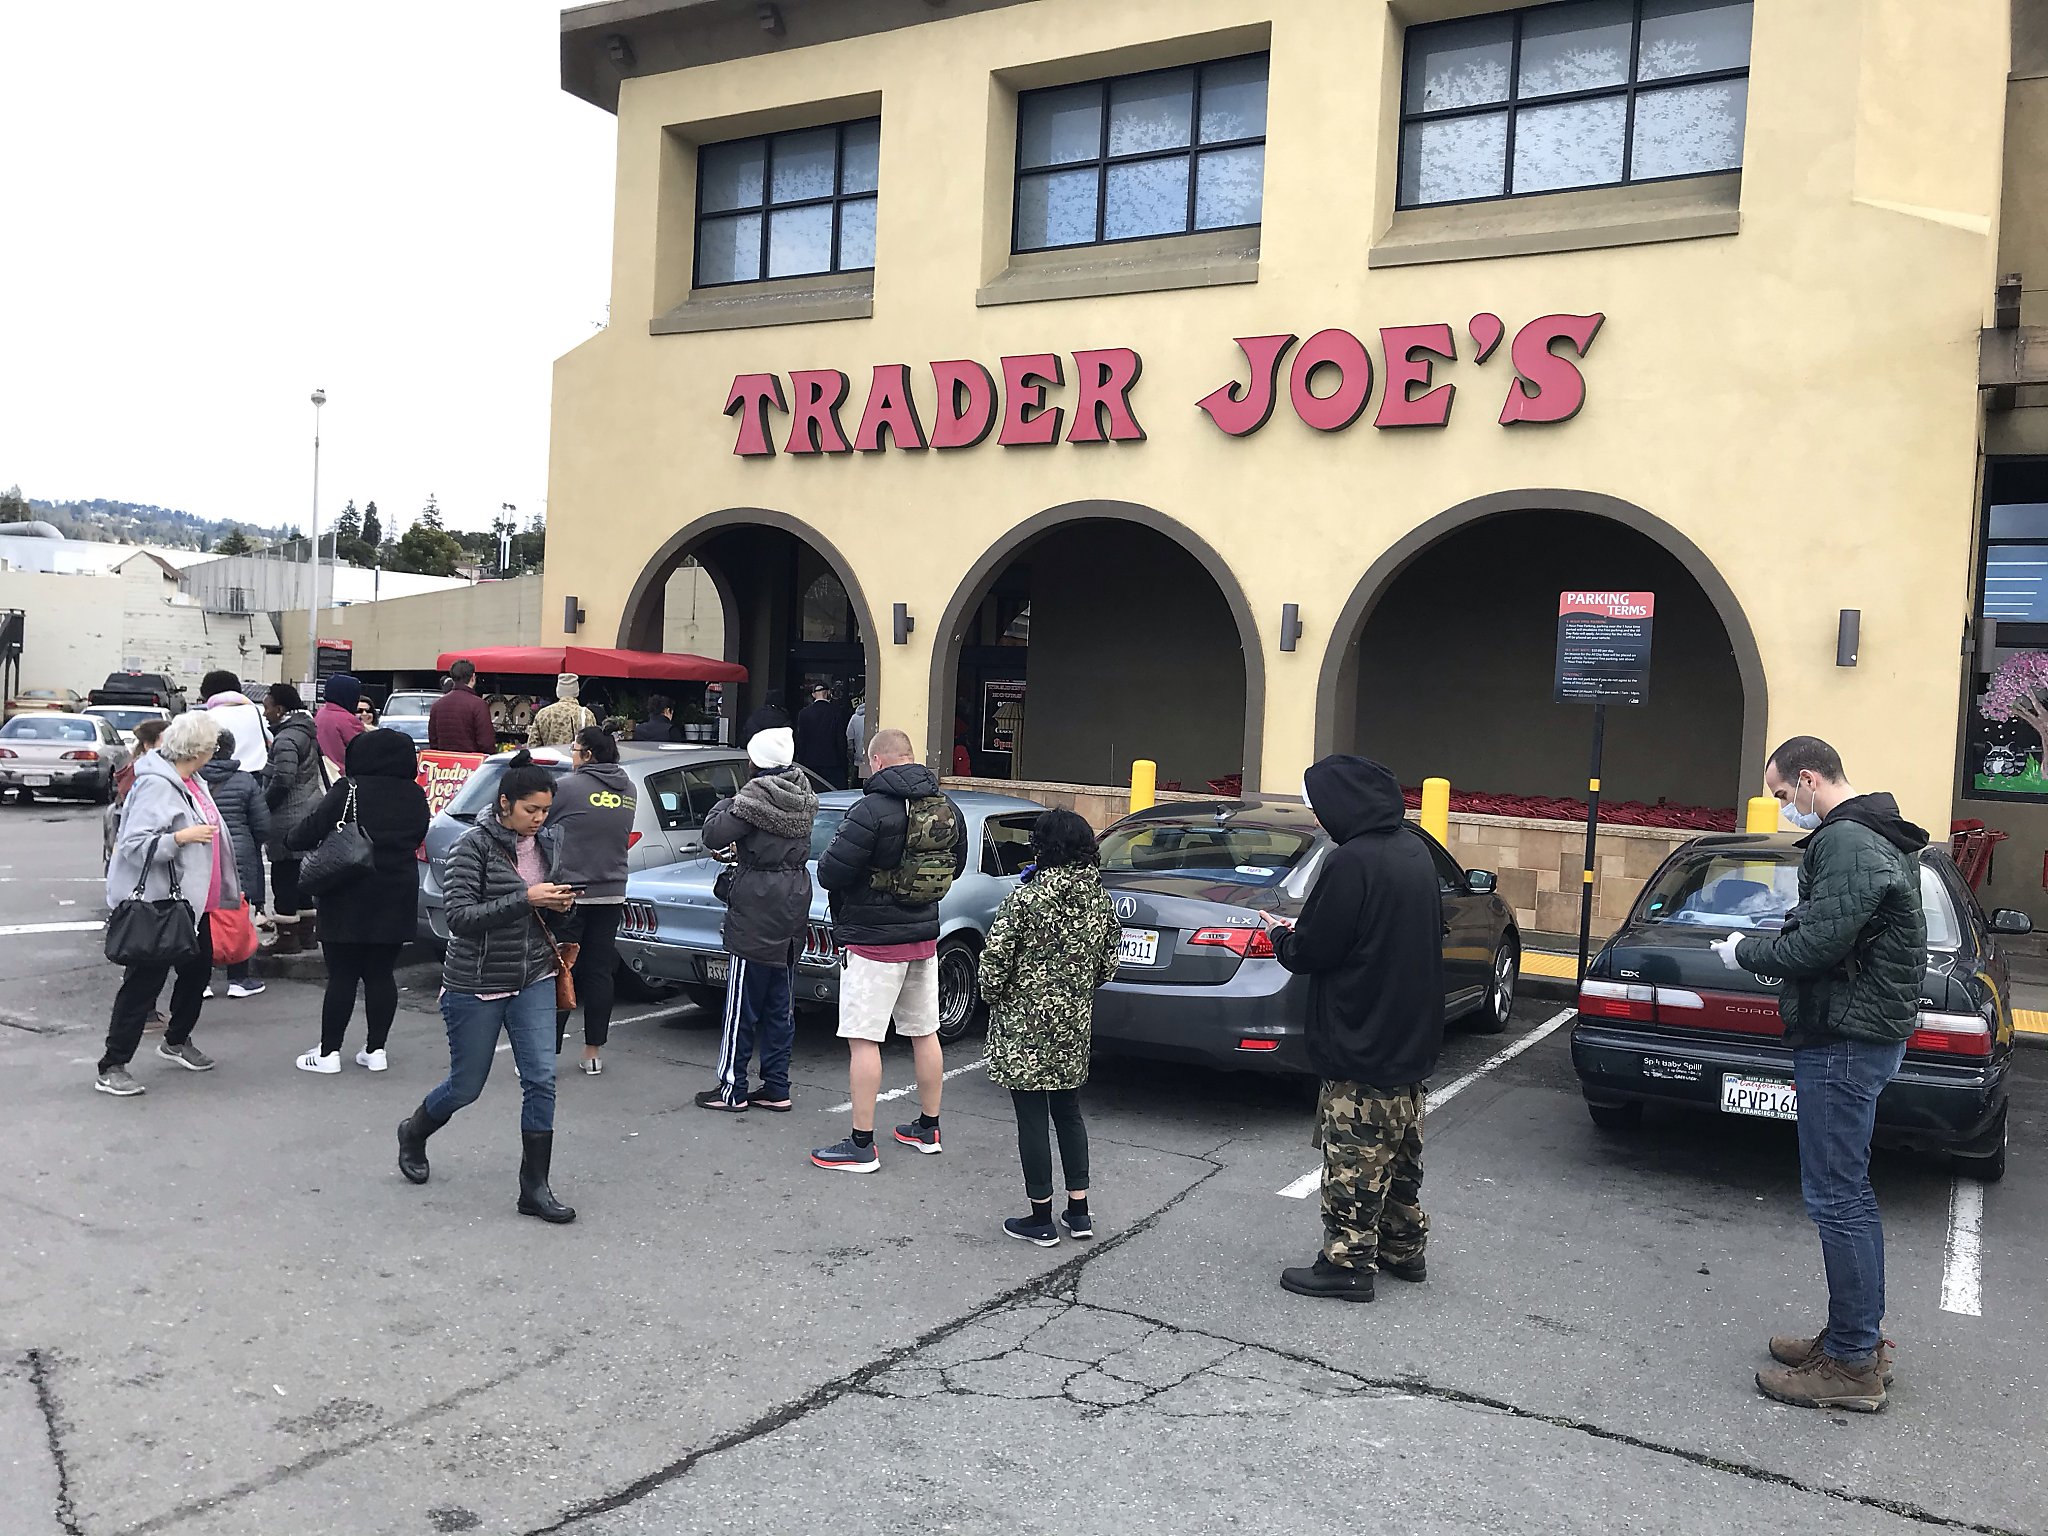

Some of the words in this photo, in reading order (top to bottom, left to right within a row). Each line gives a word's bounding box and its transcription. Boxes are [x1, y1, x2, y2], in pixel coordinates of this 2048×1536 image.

[724, 348, 1147, 457] TRADER
[1196, 312, 1605, 437] JOE'S
[1567, 593, 1630, 605] PARKING
[1607, 605, 1647, 616] TERMS
[1226, 916, 1252, 925] ILX
[1620, 969, 1640, 978] DX
[1743, 1107, 1775, 1117] FRANCISCO
[1776, 1111, 1798, 1120] TOYOTA
